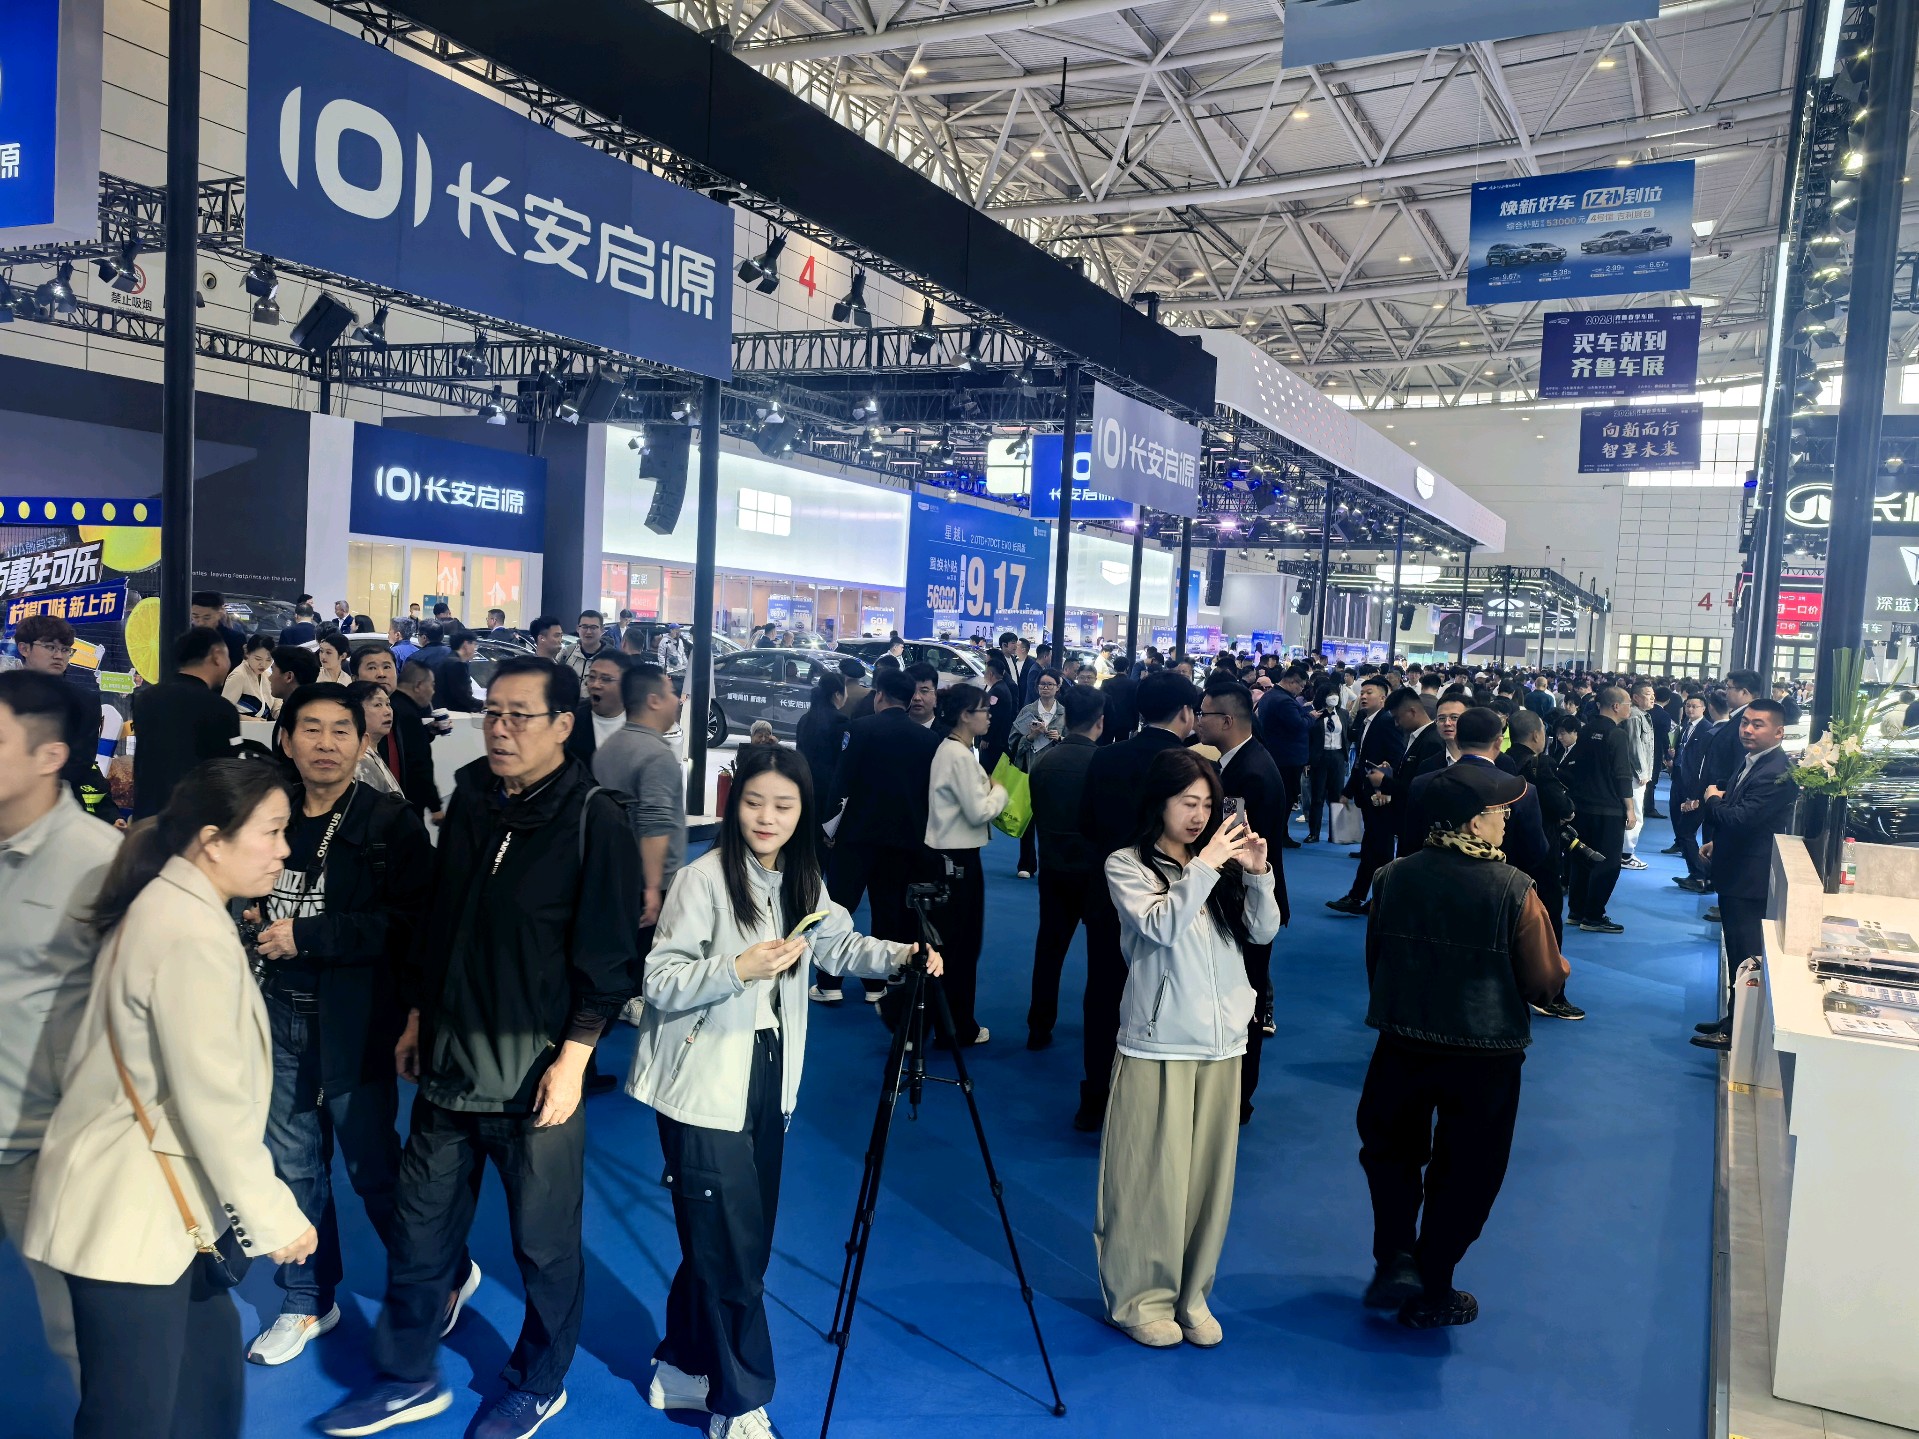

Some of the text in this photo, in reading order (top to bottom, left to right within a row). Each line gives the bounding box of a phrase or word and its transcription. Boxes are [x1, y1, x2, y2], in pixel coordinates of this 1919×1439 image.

[1499, 194, 1577, 216] 焕新好车
[1506, 220, 1539, 231] 综合补贴
[447, 161, 715, 321] 长安启源
[799, 256, 816, 297] 4
[111, 291, 152, 312] 禁止吸烟
[1585, 315, 1613, 326] 2025
[1573, 330, 1667, 353] 买车就到
[1572, 356, 1665, 378] 齐鲁车展
[1603, 421, 1680, 438] 向新而行
[1602, 440, 1680, 458] 智享未来
[1129, 433, 1196, 489] 长安启源
[424, 475, 526, 515] 长安启源
[926, 584, 957, 610] 56000
[966, 556, 1027, 617] 9.17
[68, 591, 117, 618] 新上市
[1698, 592, 1713, 611] 4
[316, 812, 342, 858] OLYMPUS
